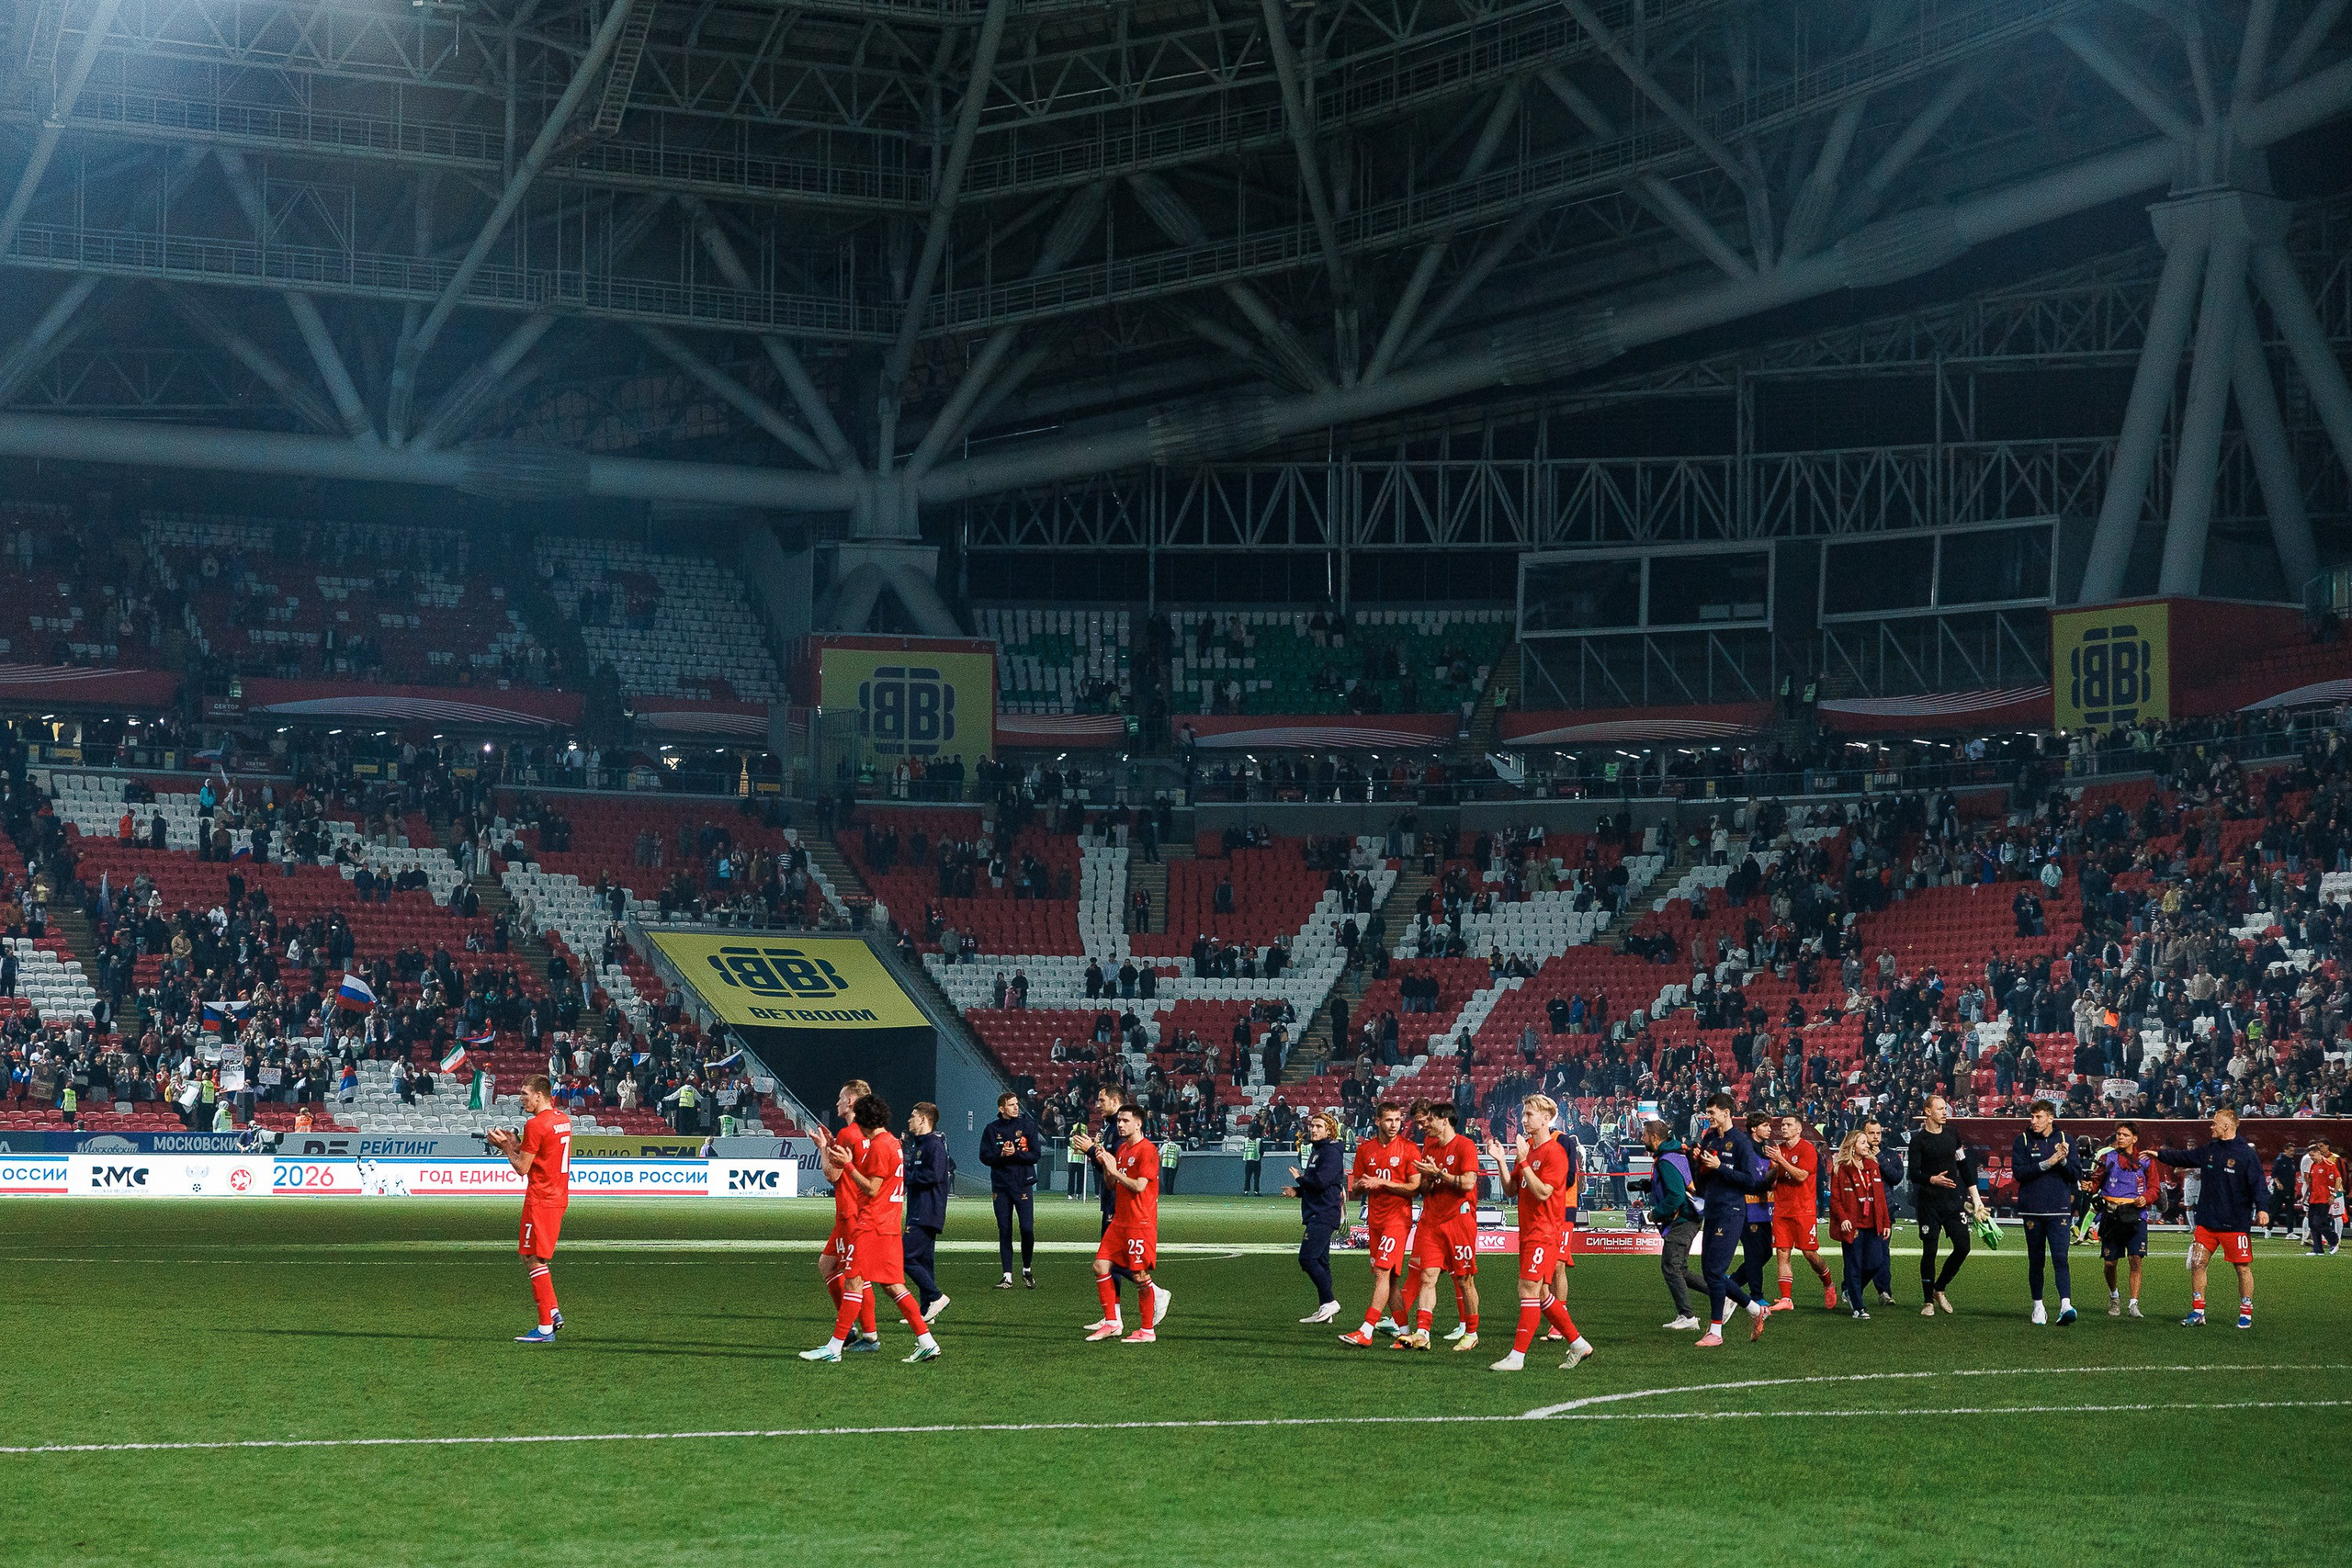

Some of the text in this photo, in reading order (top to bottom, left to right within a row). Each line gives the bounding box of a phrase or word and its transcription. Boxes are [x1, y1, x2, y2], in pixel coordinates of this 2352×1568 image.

[748, 1007, 879, 1021] BETBOOM
[359, 1138, 438, 1155] РЕЙТИНГ
[560, 1135, 571, 1173] 7
[0, 1168, 68, 1180] ОССИИ
[273, 1166, 334, 1187] 2026
[420, 1170, 453, 1184] ГОД
[569, 1171, 634, 1185] АРОДОВ
[639, 1171, 708, 1184] РОССИИ
[525, 1223, 533, 1239] 7
[1808, 1224, 1816, 1237] 4
[1128, 1239, 1145, 1255] 25
[1378, 1235, 1396, 1253] 20
[1586, 1237, 1633, 1247] СИЛЬНЫЕ
[2237, 1235, 2248, 1249] 10
[1454, 1245, 1473, 1261] 30
[1532, 1247, 1544, 1265] 8
